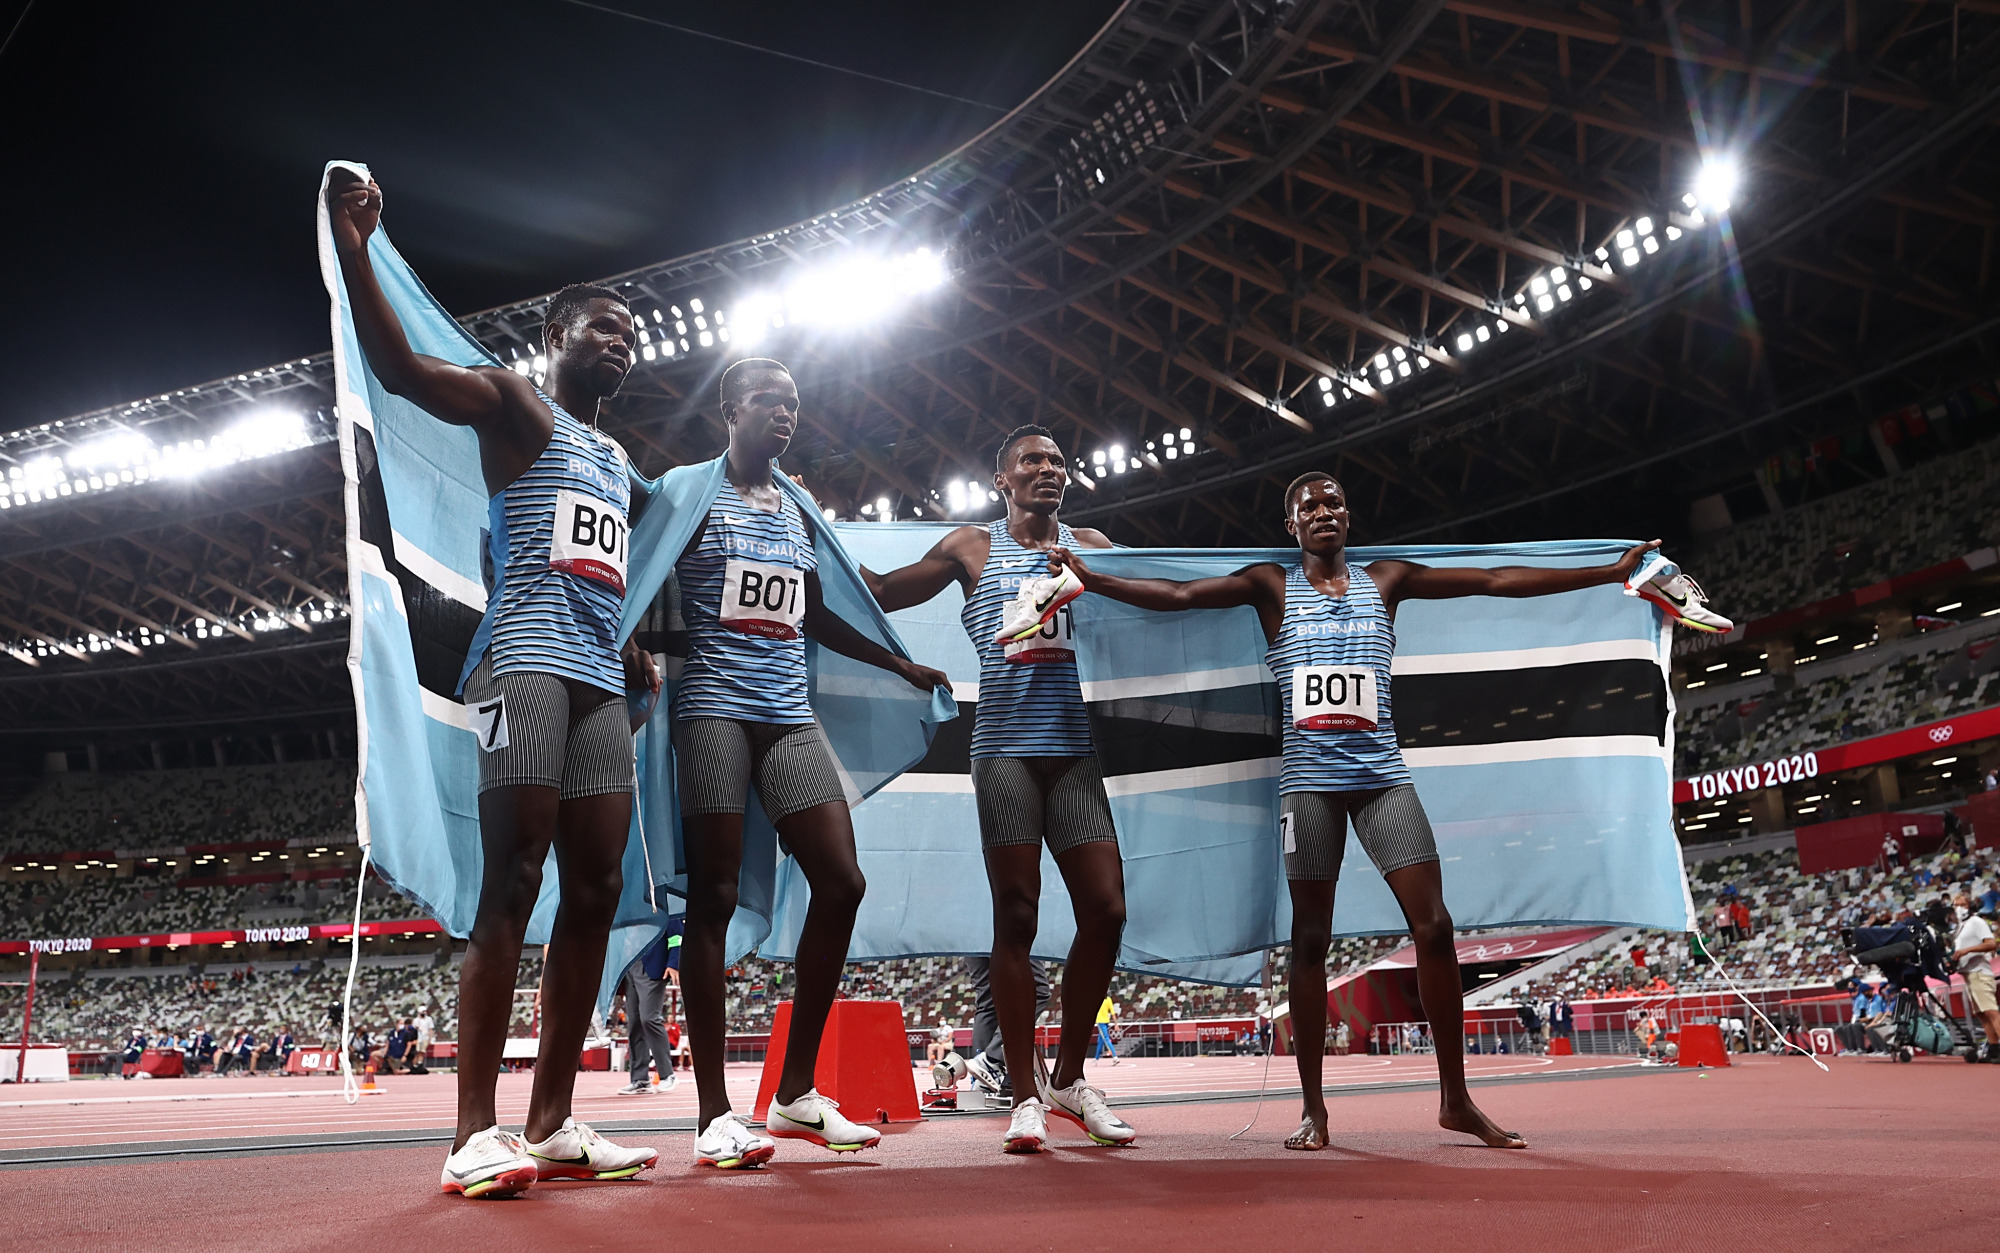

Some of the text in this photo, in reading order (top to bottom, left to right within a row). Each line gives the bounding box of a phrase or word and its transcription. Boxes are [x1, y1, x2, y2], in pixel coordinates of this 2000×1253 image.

[572, 503, 626, 563] BOT
[585, 565, 601, 574] TOKYO
[739, 569, 799, 615] BOT
[1026, 607, 1072, 640] OT
[1297, 621, 1377, 636] BOTSWANA
[1305, 673, 1366, 706] BOT
[478, 700, 502, 748] 7
[1688, 752, 1819, 801] TOKYO 2020
[29, 937, 92, 954] TOKYO 2020
[245, 925, 310, 943] TOKYO 2020
[1816, 1034, 1829, 1052] 9
